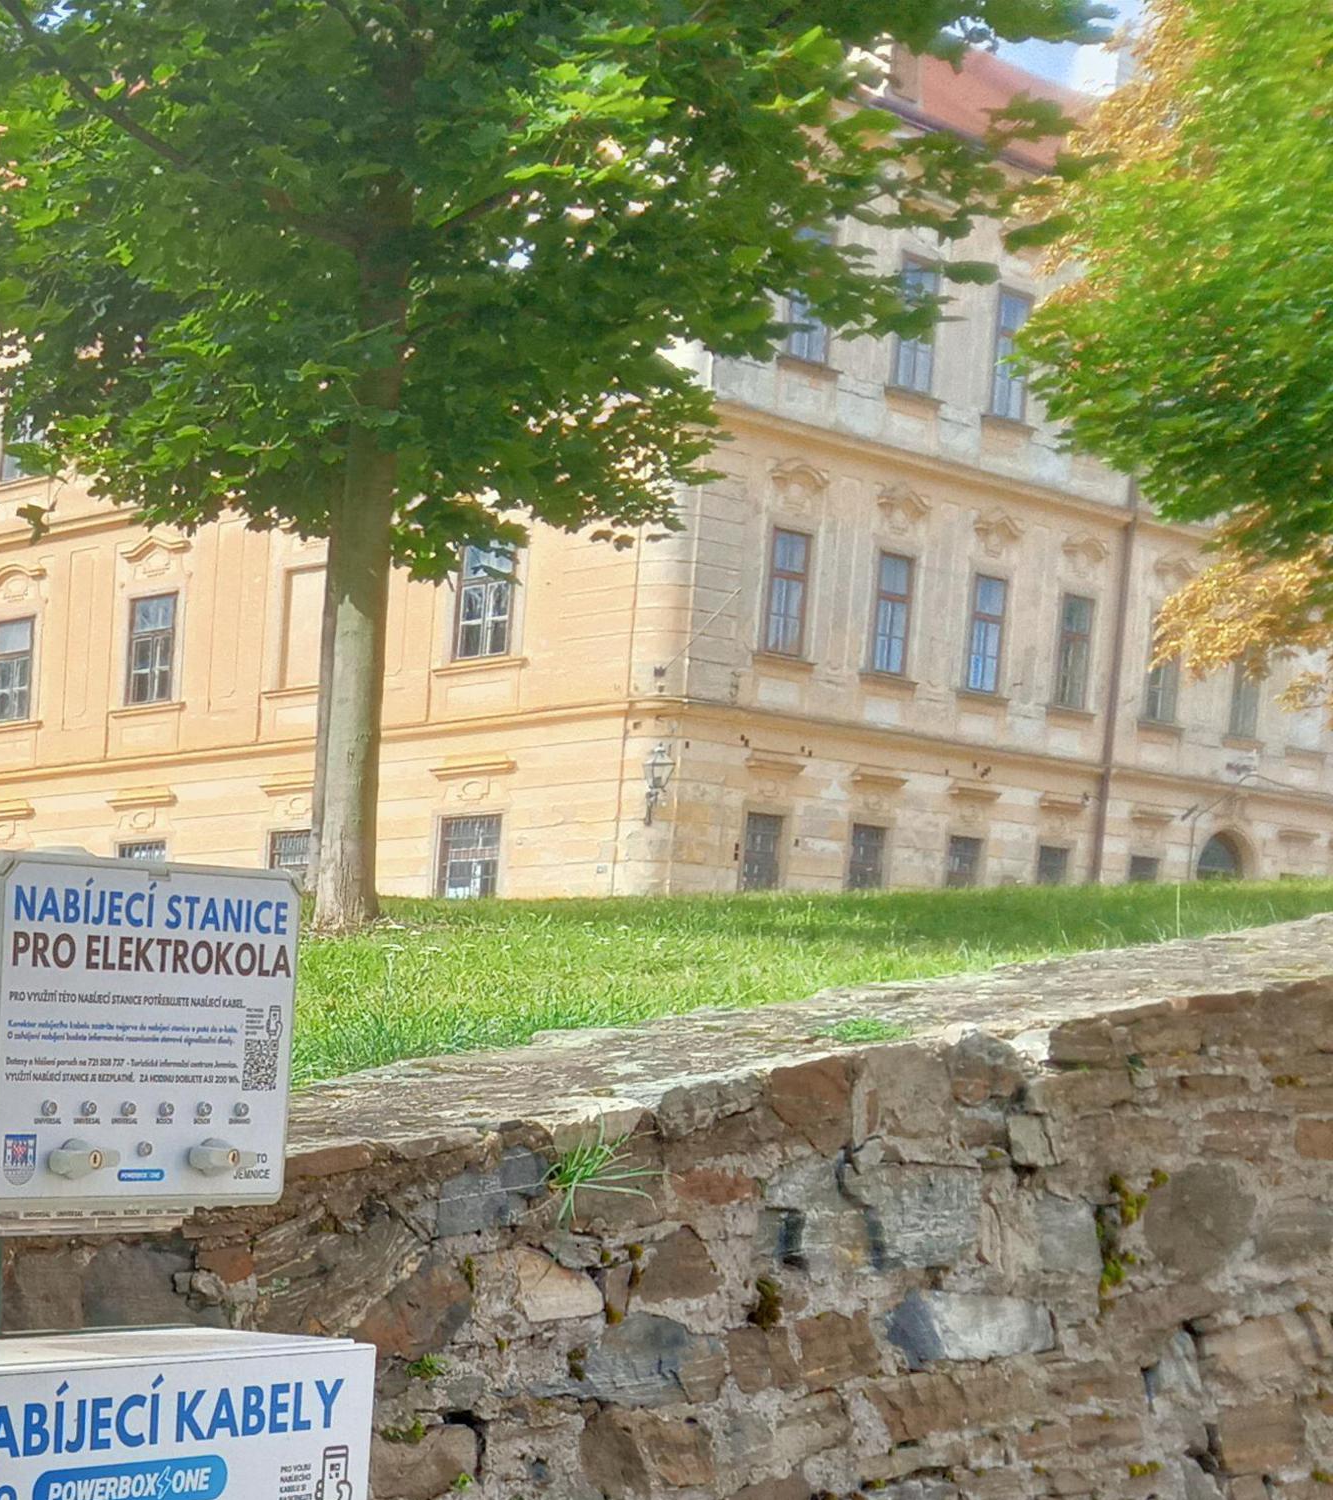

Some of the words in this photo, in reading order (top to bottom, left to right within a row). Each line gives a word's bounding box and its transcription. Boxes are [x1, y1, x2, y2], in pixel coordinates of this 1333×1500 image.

[14, 878, 157, 928] NABÍJECÍ
[165, 894, 289, 935] STANICE
[12, 931, 76, 968] PRO
[85, 934, 291, 978] ELEKTROKOLA
[9, 990, 25, 1001] PRO
[112, 994, 142, 1005] STANICE
[175, 1378, 345, 1443] KABELY
[170, 1467, 212, 1494] ONE
